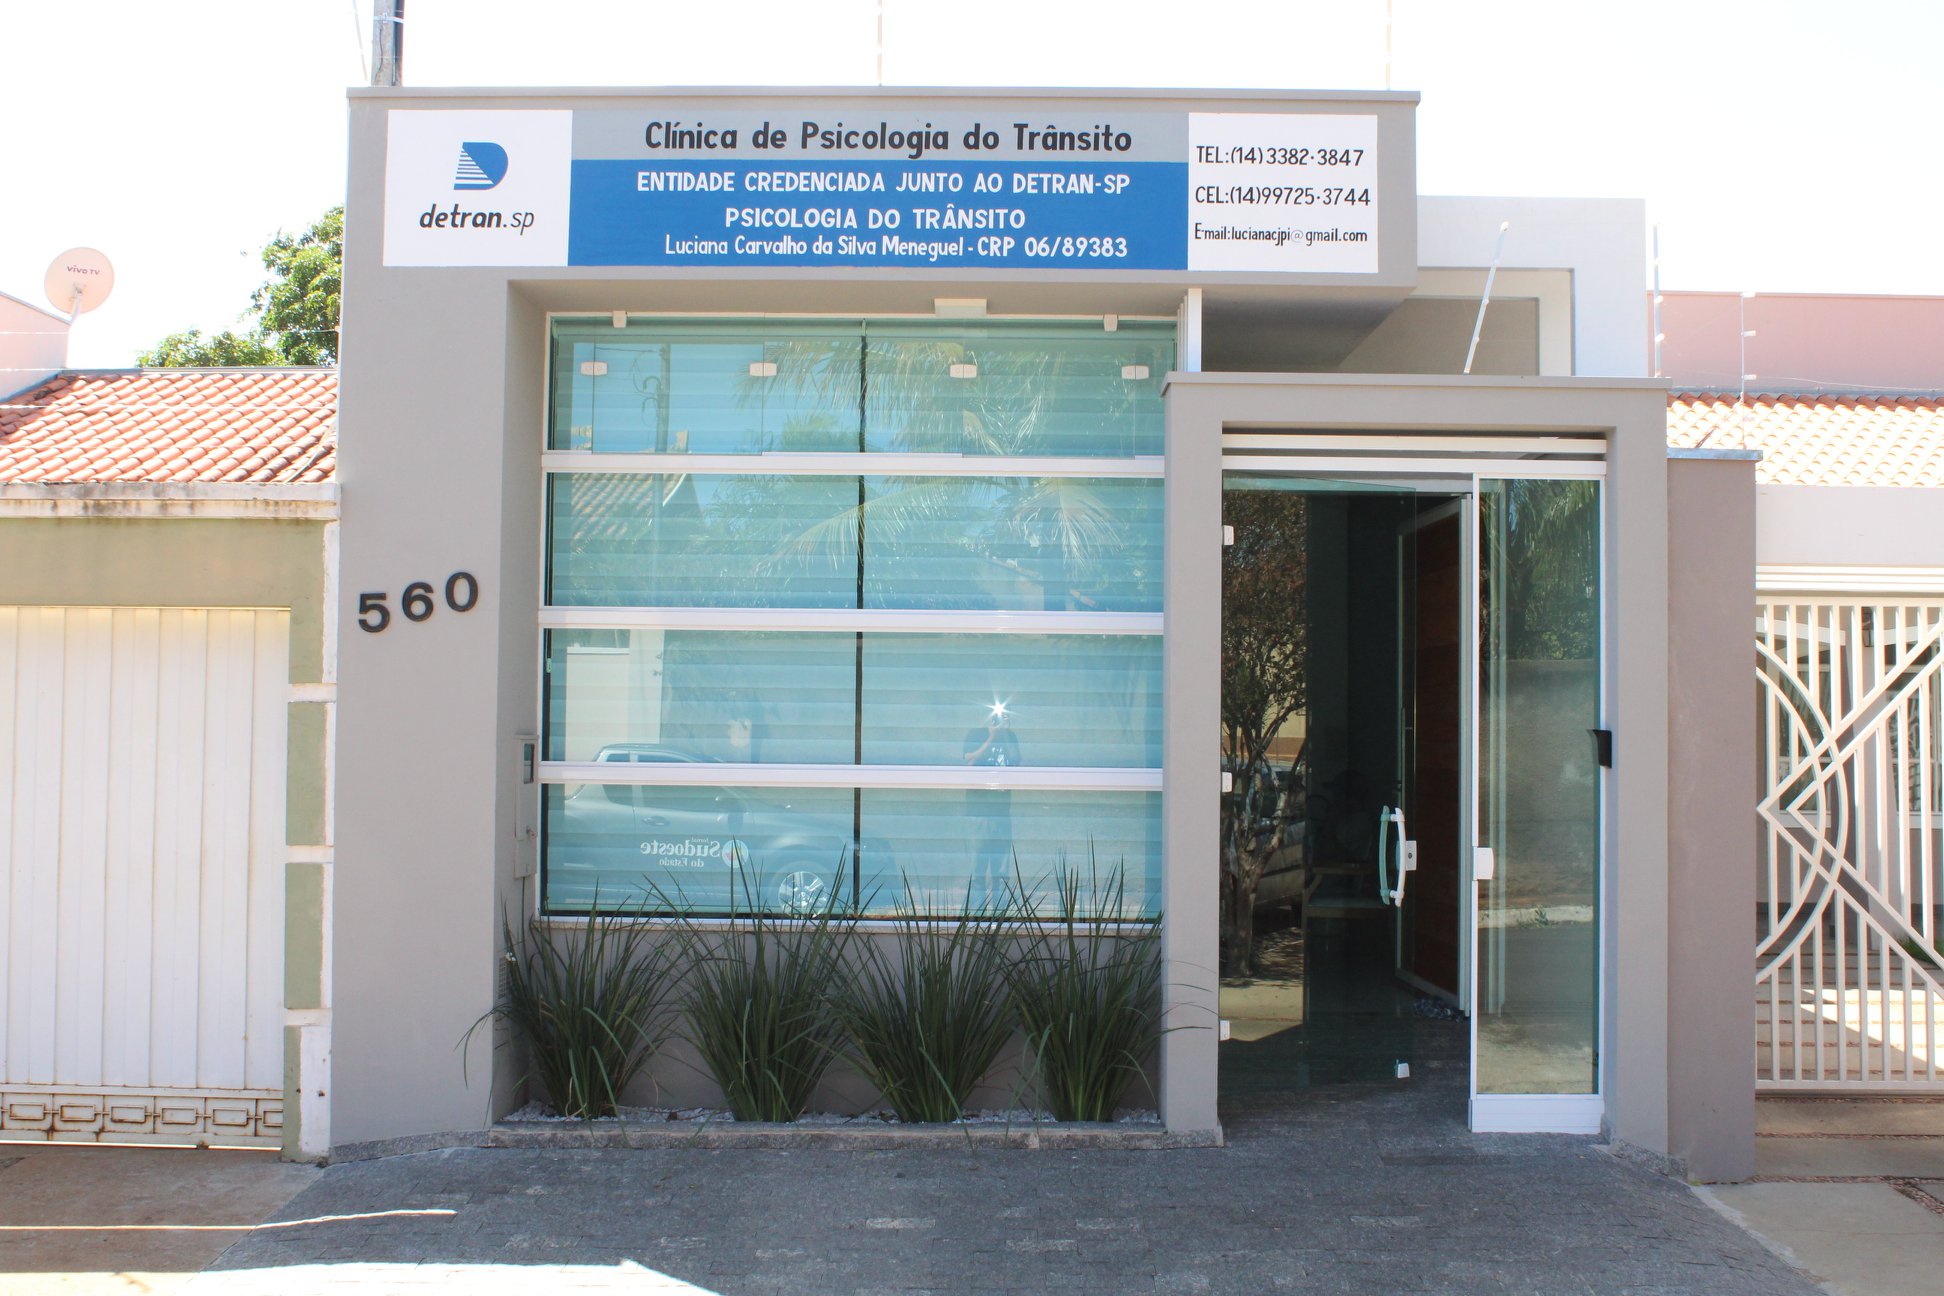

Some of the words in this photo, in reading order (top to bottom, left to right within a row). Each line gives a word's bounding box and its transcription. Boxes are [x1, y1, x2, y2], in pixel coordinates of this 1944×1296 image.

[645, 121, 738, 150] Clínica
[751, 121, 788, 150] de
[801, 121, 949, 160] Psicologia
[962, 122, 1000, 151] do
[1013, 123, 1132, 152] Trânsito
[637, 170, 736, 192] ENTIDADE
[744, 171, 885, 192] CREDENCIADA
[895, 172, 964, 193] JUNTO
[973, 172, 1003, 193] AO
[1012, 172, 1131, 195] DETRAN-SP
[419, 203, 535, 236] detran.sp
[725, 207, 858, 229] PSICOLOGIA
[868, 208, 901, 229] DO
[912, 203, 1026, 230] TRÂNSITO
[665, 233, 728, 255] Luciana
[734, 234, 808, 255] Carvalho
[812, 234, 833, 255] da
[837, 234, 877, 255] Silva
[881, 234, 964, 262] Meneguel
[977, 235, 1016, 257] CRP
[1024, 236, 1128, 258] 06/89383
[67, 265, 88, 275] vivo
[358, 571, 479, 633] 560
